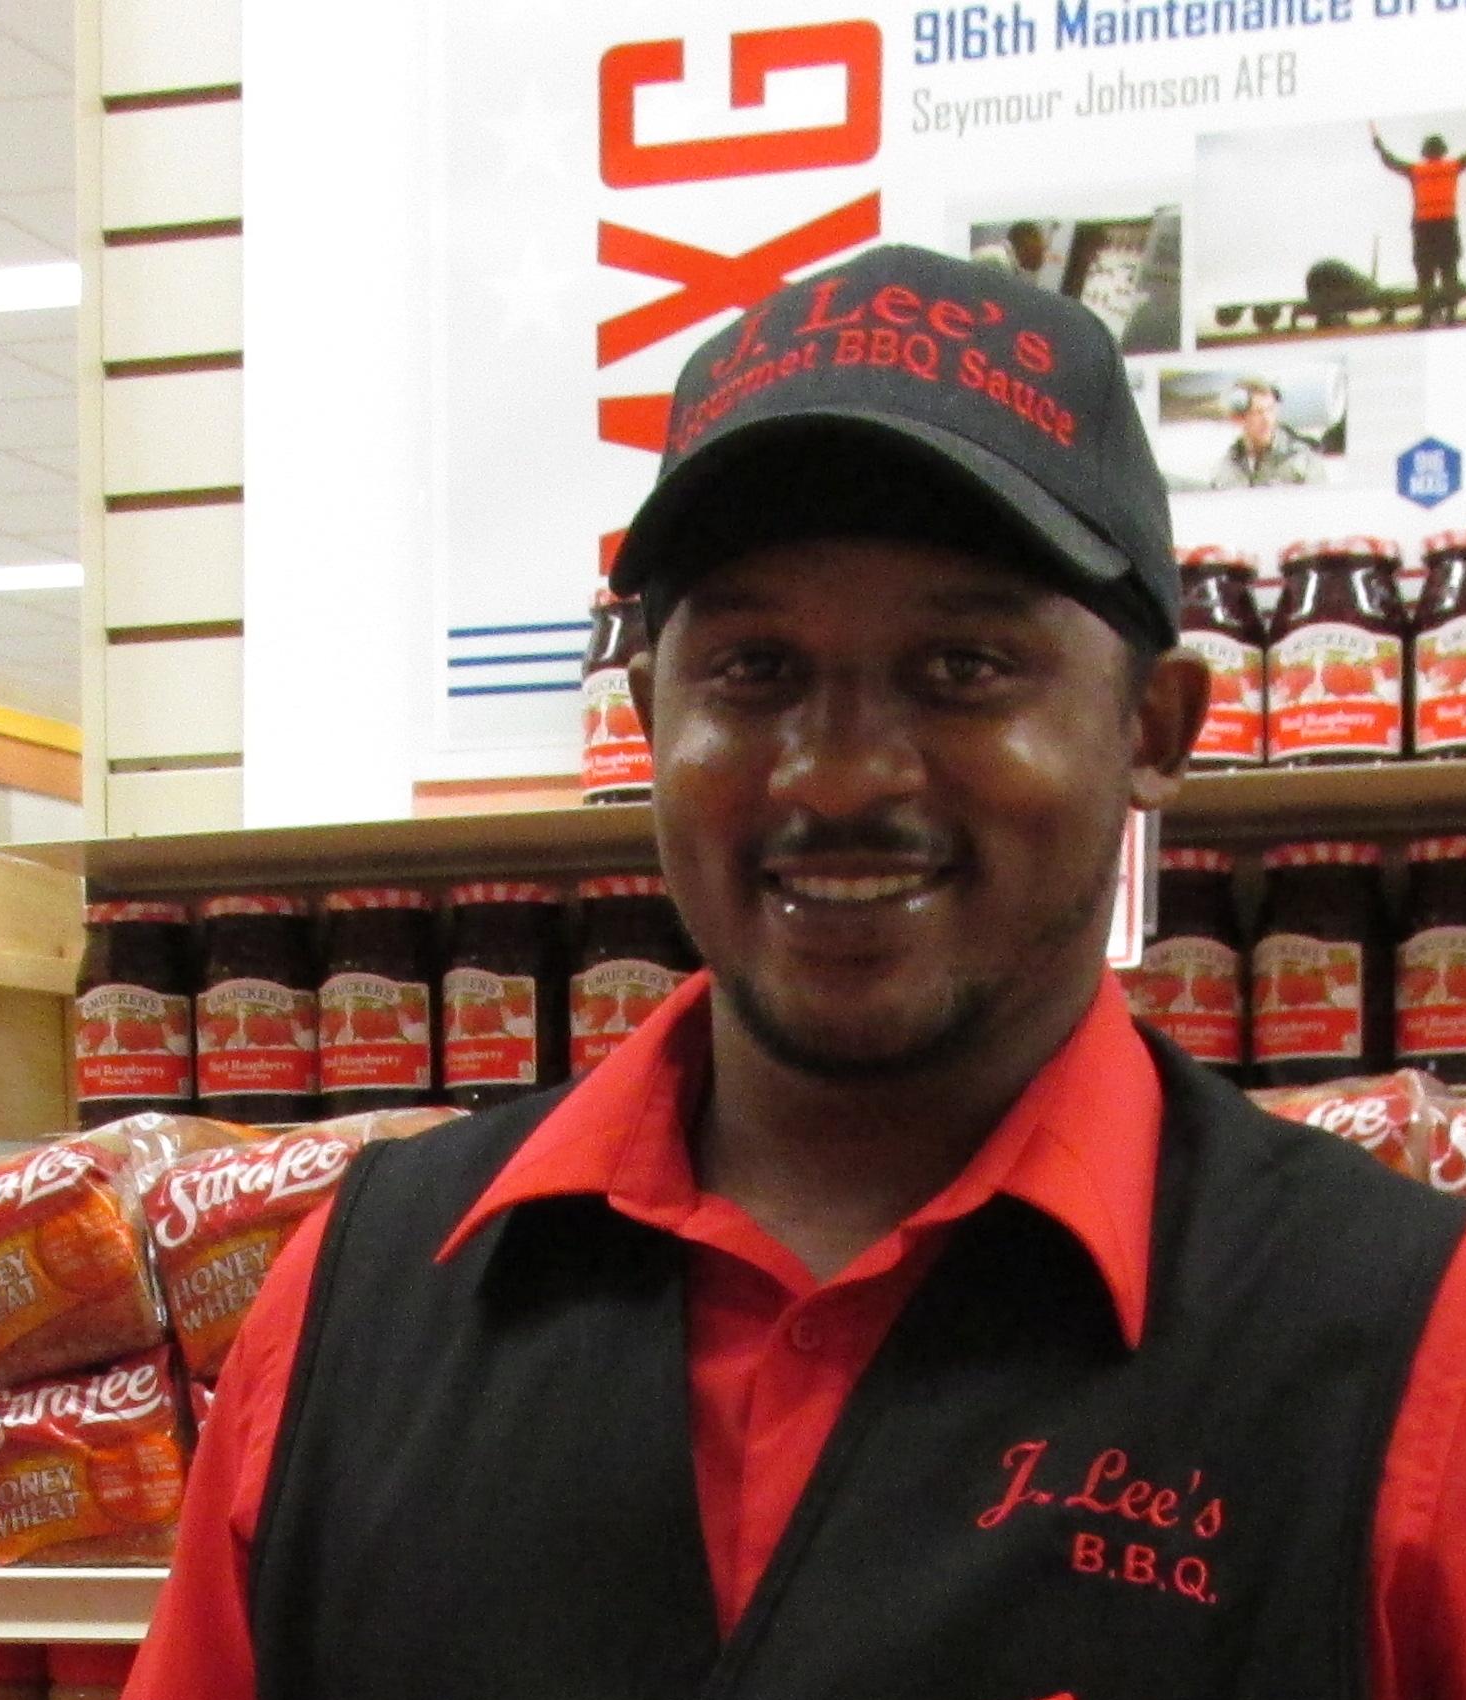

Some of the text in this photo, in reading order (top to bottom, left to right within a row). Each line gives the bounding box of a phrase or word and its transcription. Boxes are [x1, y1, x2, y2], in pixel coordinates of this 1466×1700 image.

[913, 0, 1352, 65] 916th Maintenance
[912, 51, 1297, 137] Seymour Johnson AFB
[795, 277, 1056, 375] Lee's
[832, 328, 939, 382] BBQ
[959, 345, 1076, 448] Sauce
[19, 1143, 96, 1209] Lee
[154, 1135, 350, 1248] Sara Lee
[1065, 1447, 1223, 1539] Lee's
